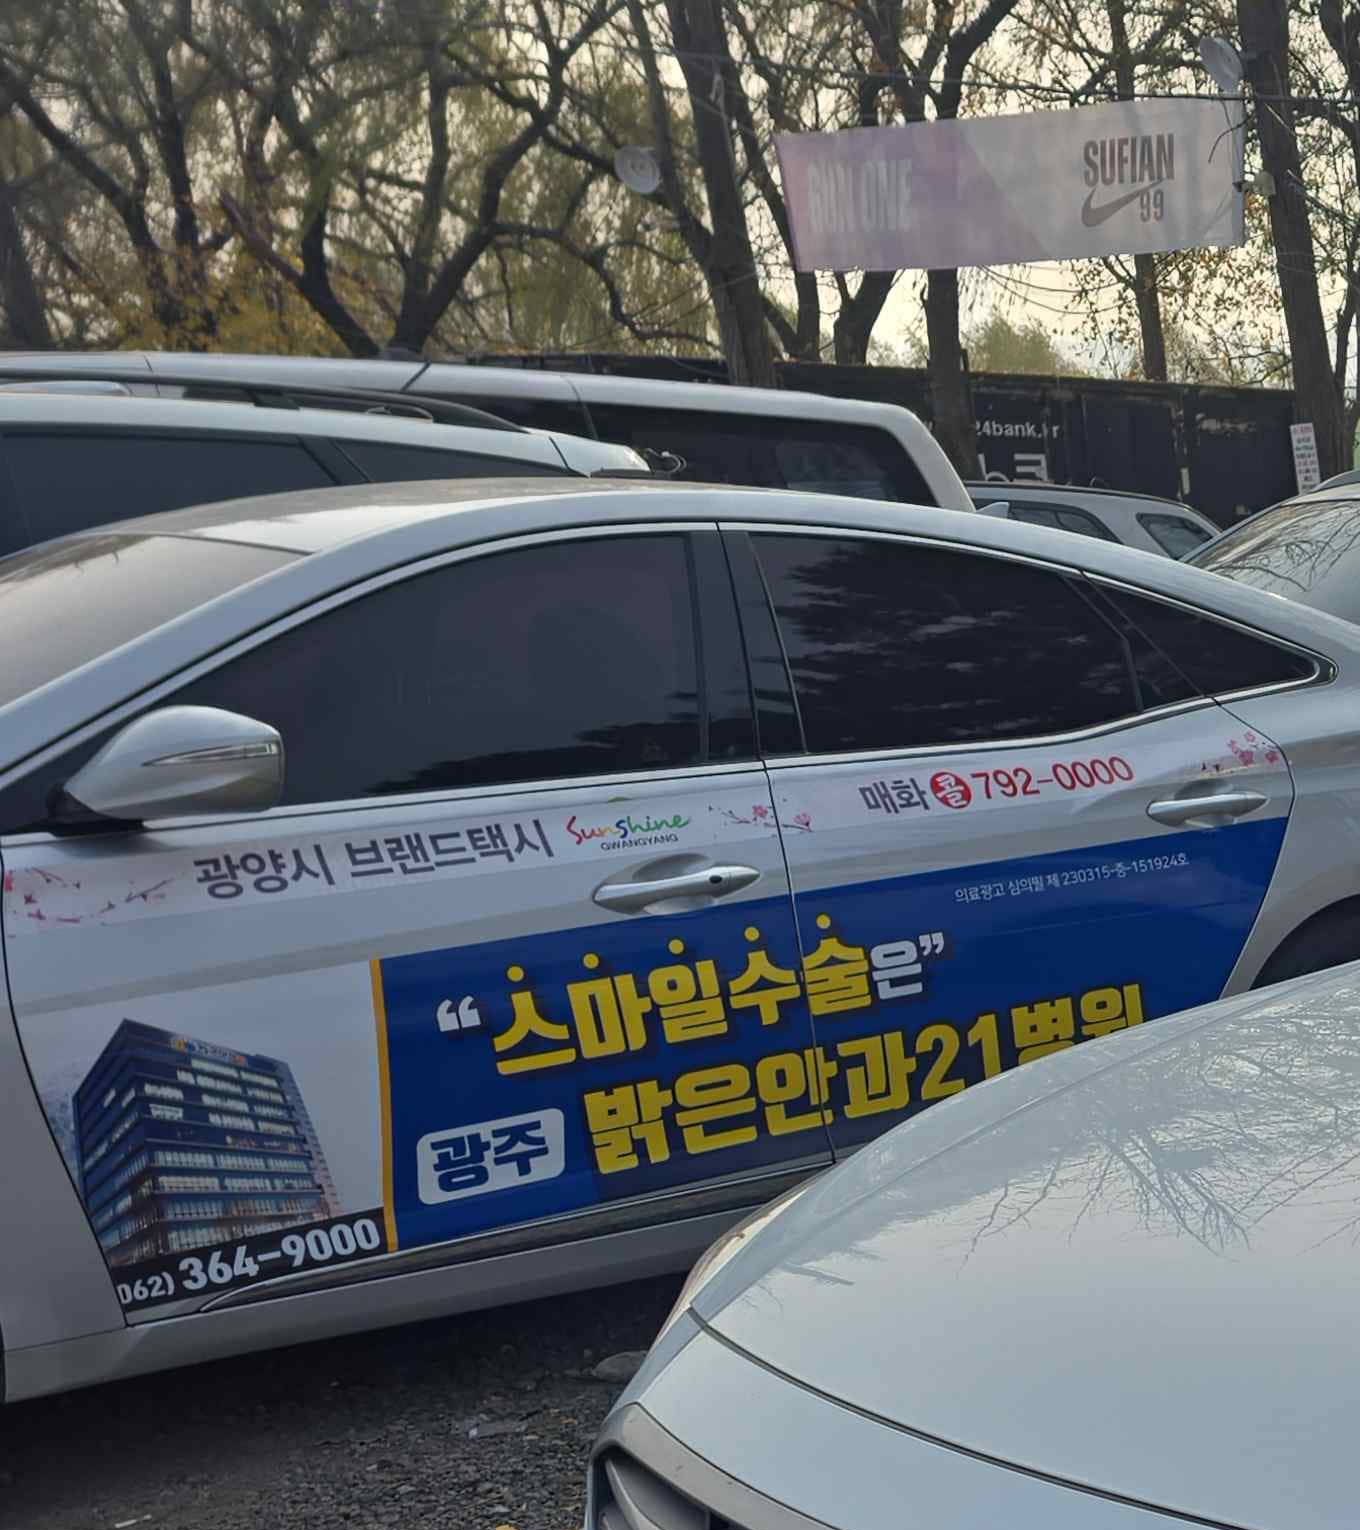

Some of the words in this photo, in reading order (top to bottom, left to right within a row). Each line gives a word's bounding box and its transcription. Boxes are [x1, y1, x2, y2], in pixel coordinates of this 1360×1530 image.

[1083, 133, 1175, 187] SUFIAN
[1139, 188, 1165, 222] 99
[858, 777, 930, 815] 매화
[971, 756, 1135, 799] 792-0000
[566, 814, 690, 845] Sunshine
[600, 833, 680, 851] GWANGYANG
[193, 839, 336, 899] 광양시
[345, 818, 555, 876] 브랜드택시
[954, 880, 1006, 904] 의료광고
[430, 1120, 549, 1194] 광주
[178, 1218, 381, 1290] 364-9000
